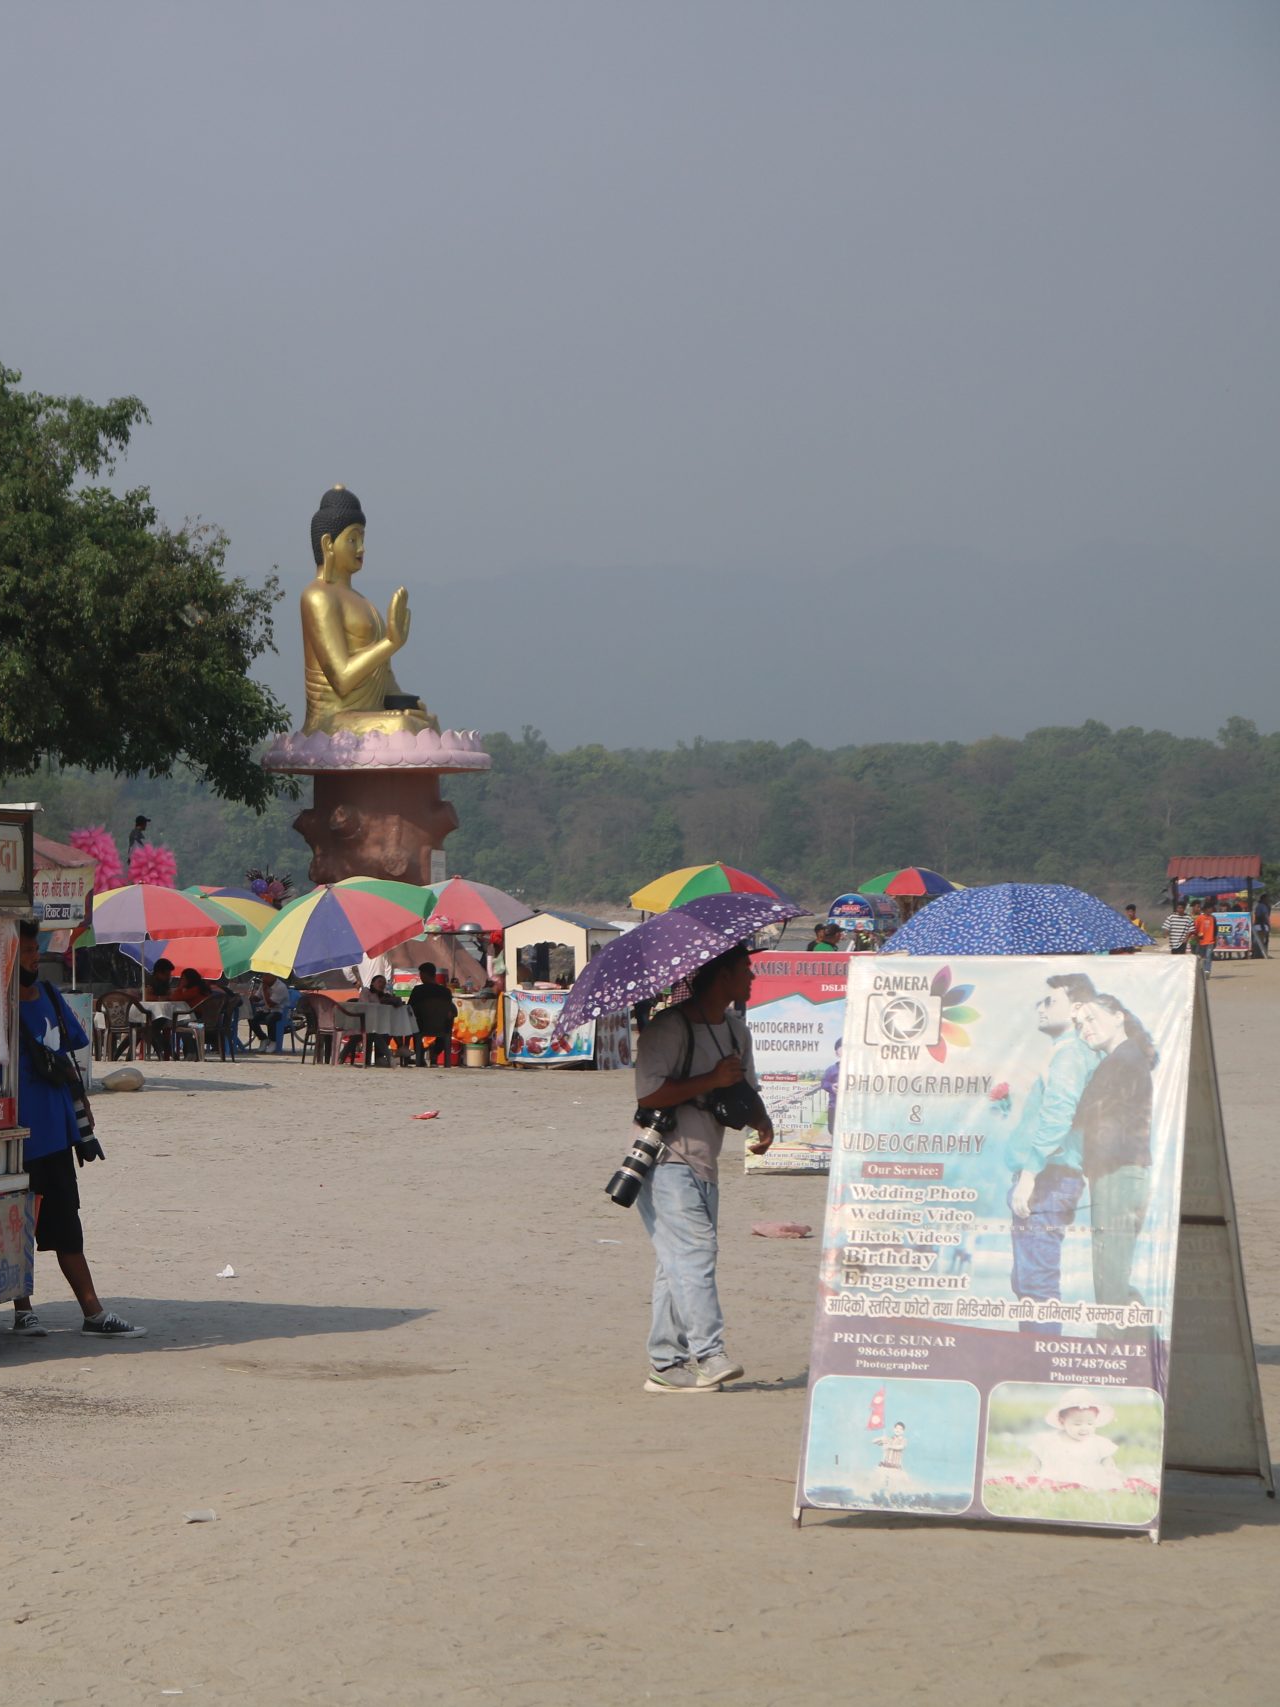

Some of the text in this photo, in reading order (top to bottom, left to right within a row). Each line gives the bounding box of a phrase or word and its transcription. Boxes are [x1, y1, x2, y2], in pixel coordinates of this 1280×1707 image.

[873, 976, 929, 991] CAMERA
[748, 1022, 824, 1034] PHOTOGRAPHY &
[755, 1040, 819, 1052] VIDEOGRAPHY
[881, 1045, 920, 1060] CREW
[846, 1075, 992, 1093] PHOTOGRAPHY
[910, 1105, 922, 1122] &
[843, 1134, 985, 1152] VIDEOGRAPHY
[868, 1165, 939, 1176] Our Service:
[852, 1186, 976, 1202] Wedding Photo
[851, 1208, 972, 1223] Wedding Video
[848, 1231, 960, 1244] Tiktok Videos
[845, 1249, 936, 1268] Birthday
[844, 1271, 968, 1289] Engagement
[827, 1295, 865, 1314] आदिको
[869, 1296, 901, 1315] स्तरिय
[905, 1297, 930, 1316] फोटो
[933, 1302, 953, 1317] तथा
[956, 1298, 1005, 1319] भिडियोको
[1009, 1299, 1034, 1318] लागि
[1038, 1301, 1082, 1321] हामिलाई
[1127, 1304, 1153, 1324] होला
[833, 1331, 956, 1348] PRINCE SUNAR
[858, 1346, 929, 1358] 9866360489
[1035, 1341, 1147, 1358] ROSHAN ALE
[856, 1359, 930, 1371] Photographer
[1052, 1357, 1128, 1370] 9817487665
[1050, 1371, 1128, 1384] Photographer
